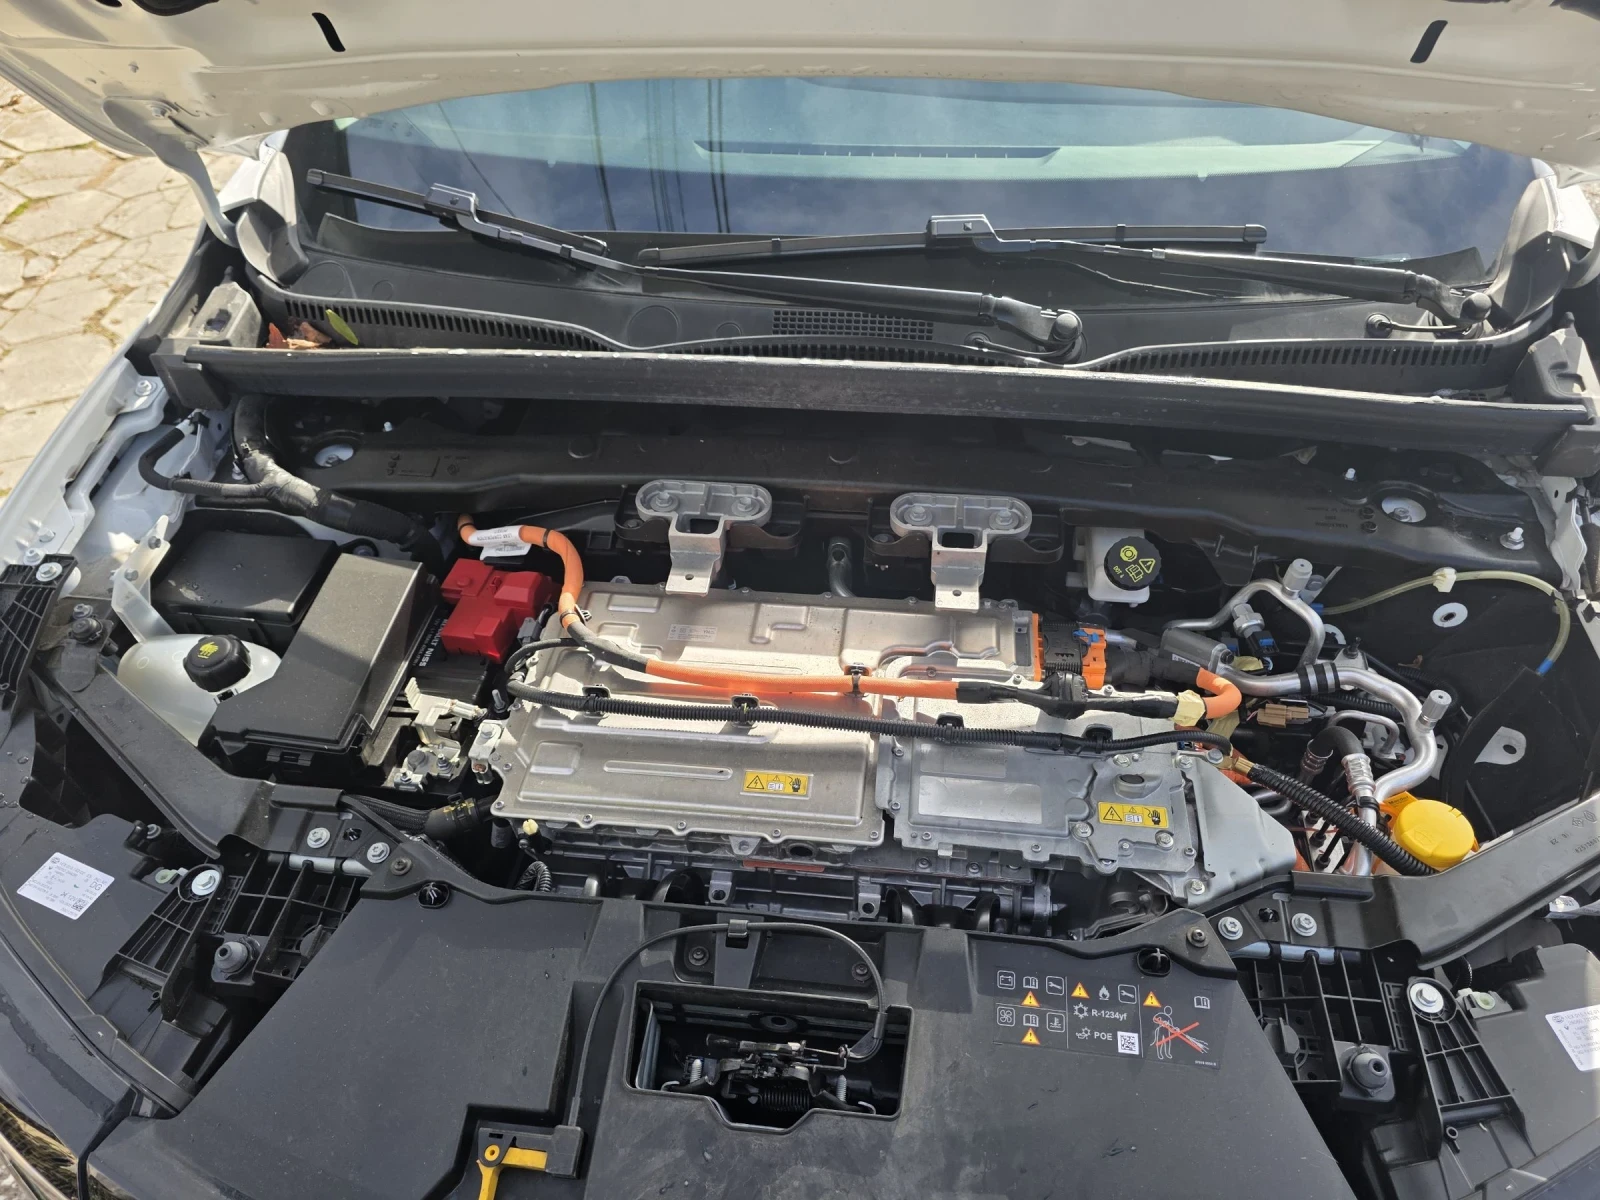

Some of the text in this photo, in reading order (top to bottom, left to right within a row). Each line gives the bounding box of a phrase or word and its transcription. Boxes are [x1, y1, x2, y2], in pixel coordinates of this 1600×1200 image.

[1113, 565, 1122, 574] DOT
[1091, 1008, 1127, 1021] R-1234yf
[1094, 1031, 1113, 1041] POE
